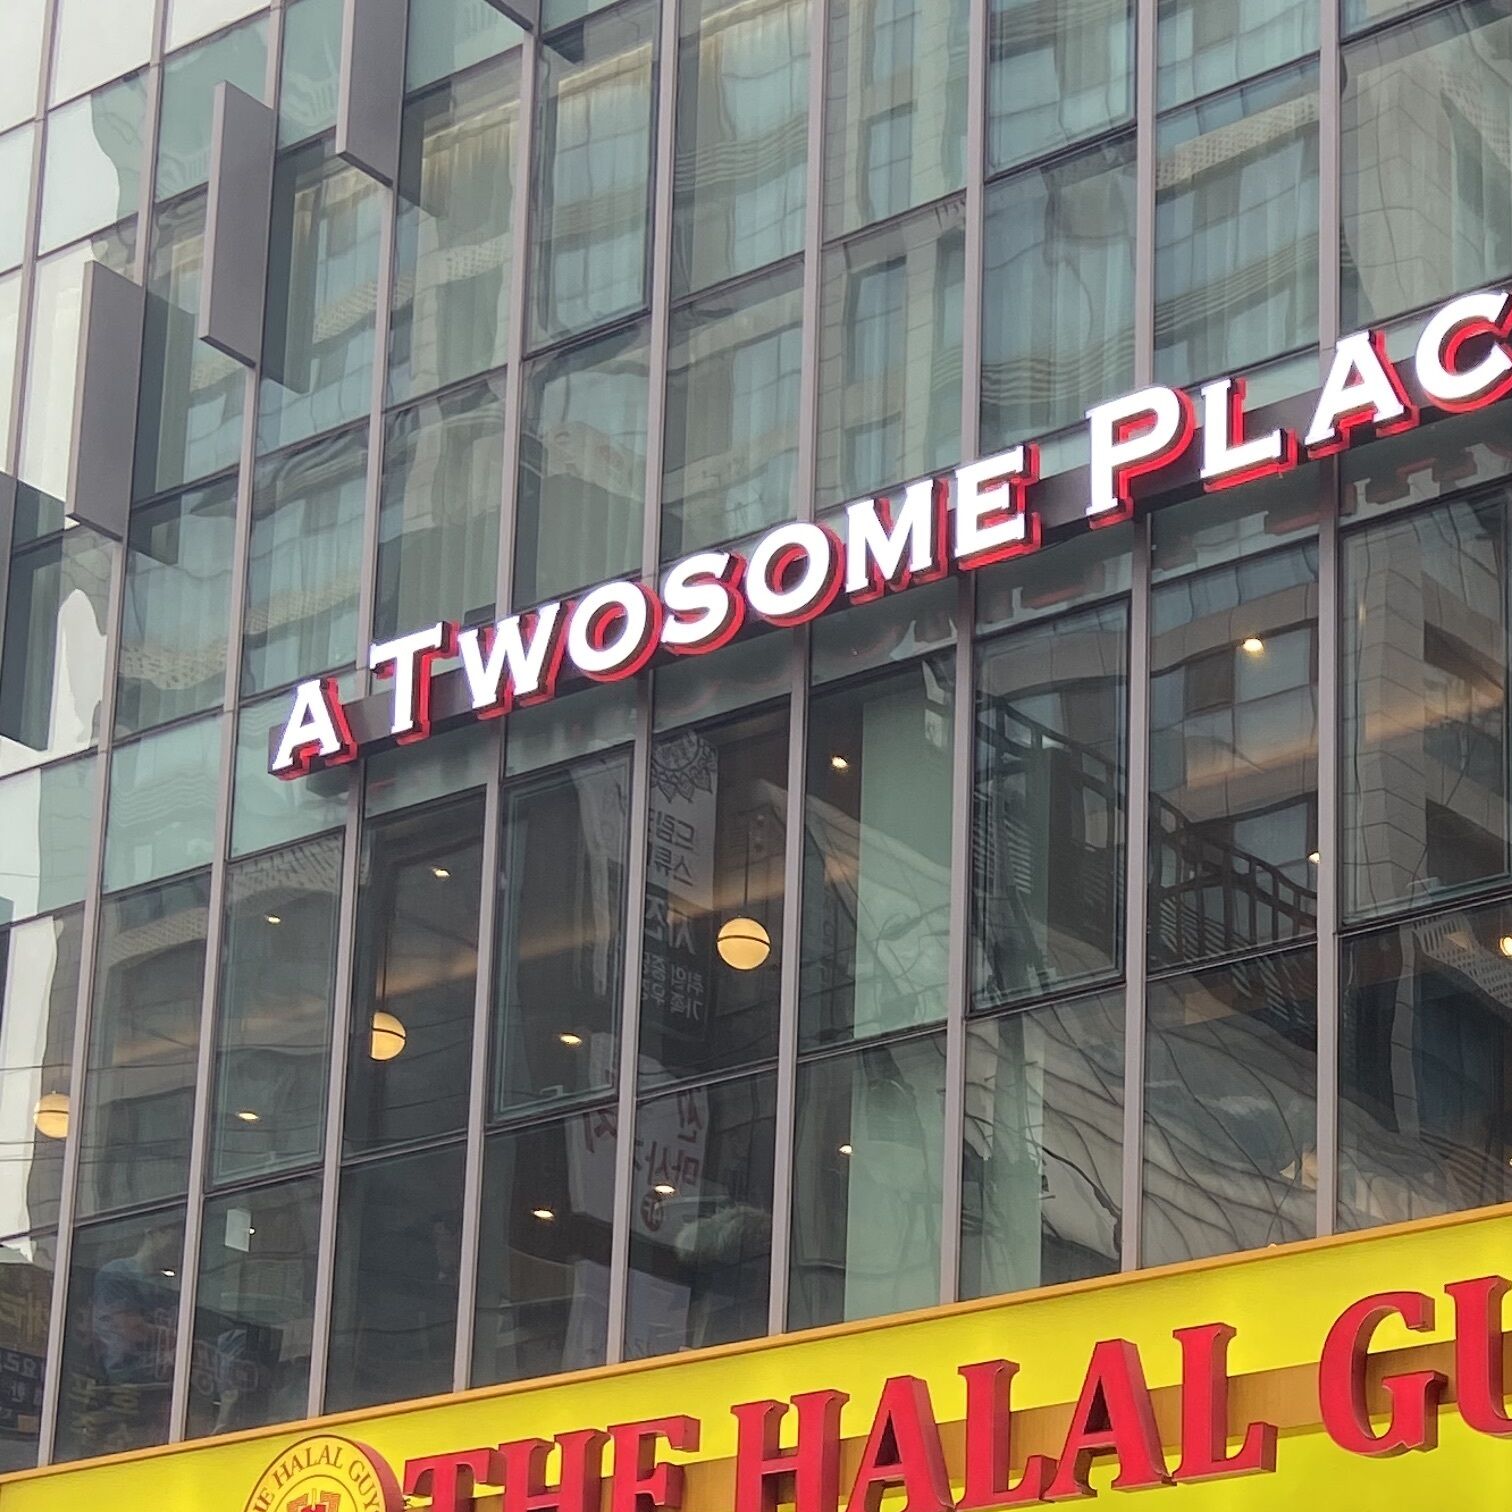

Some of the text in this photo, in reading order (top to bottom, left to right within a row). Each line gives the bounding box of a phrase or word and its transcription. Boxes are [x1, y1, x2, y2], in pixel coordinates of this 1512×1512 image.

[271, 679, 355, 778] A
[370, 442, 1043, 745] TWOSOME
[271, 1444, 343, 1490] HALAL
